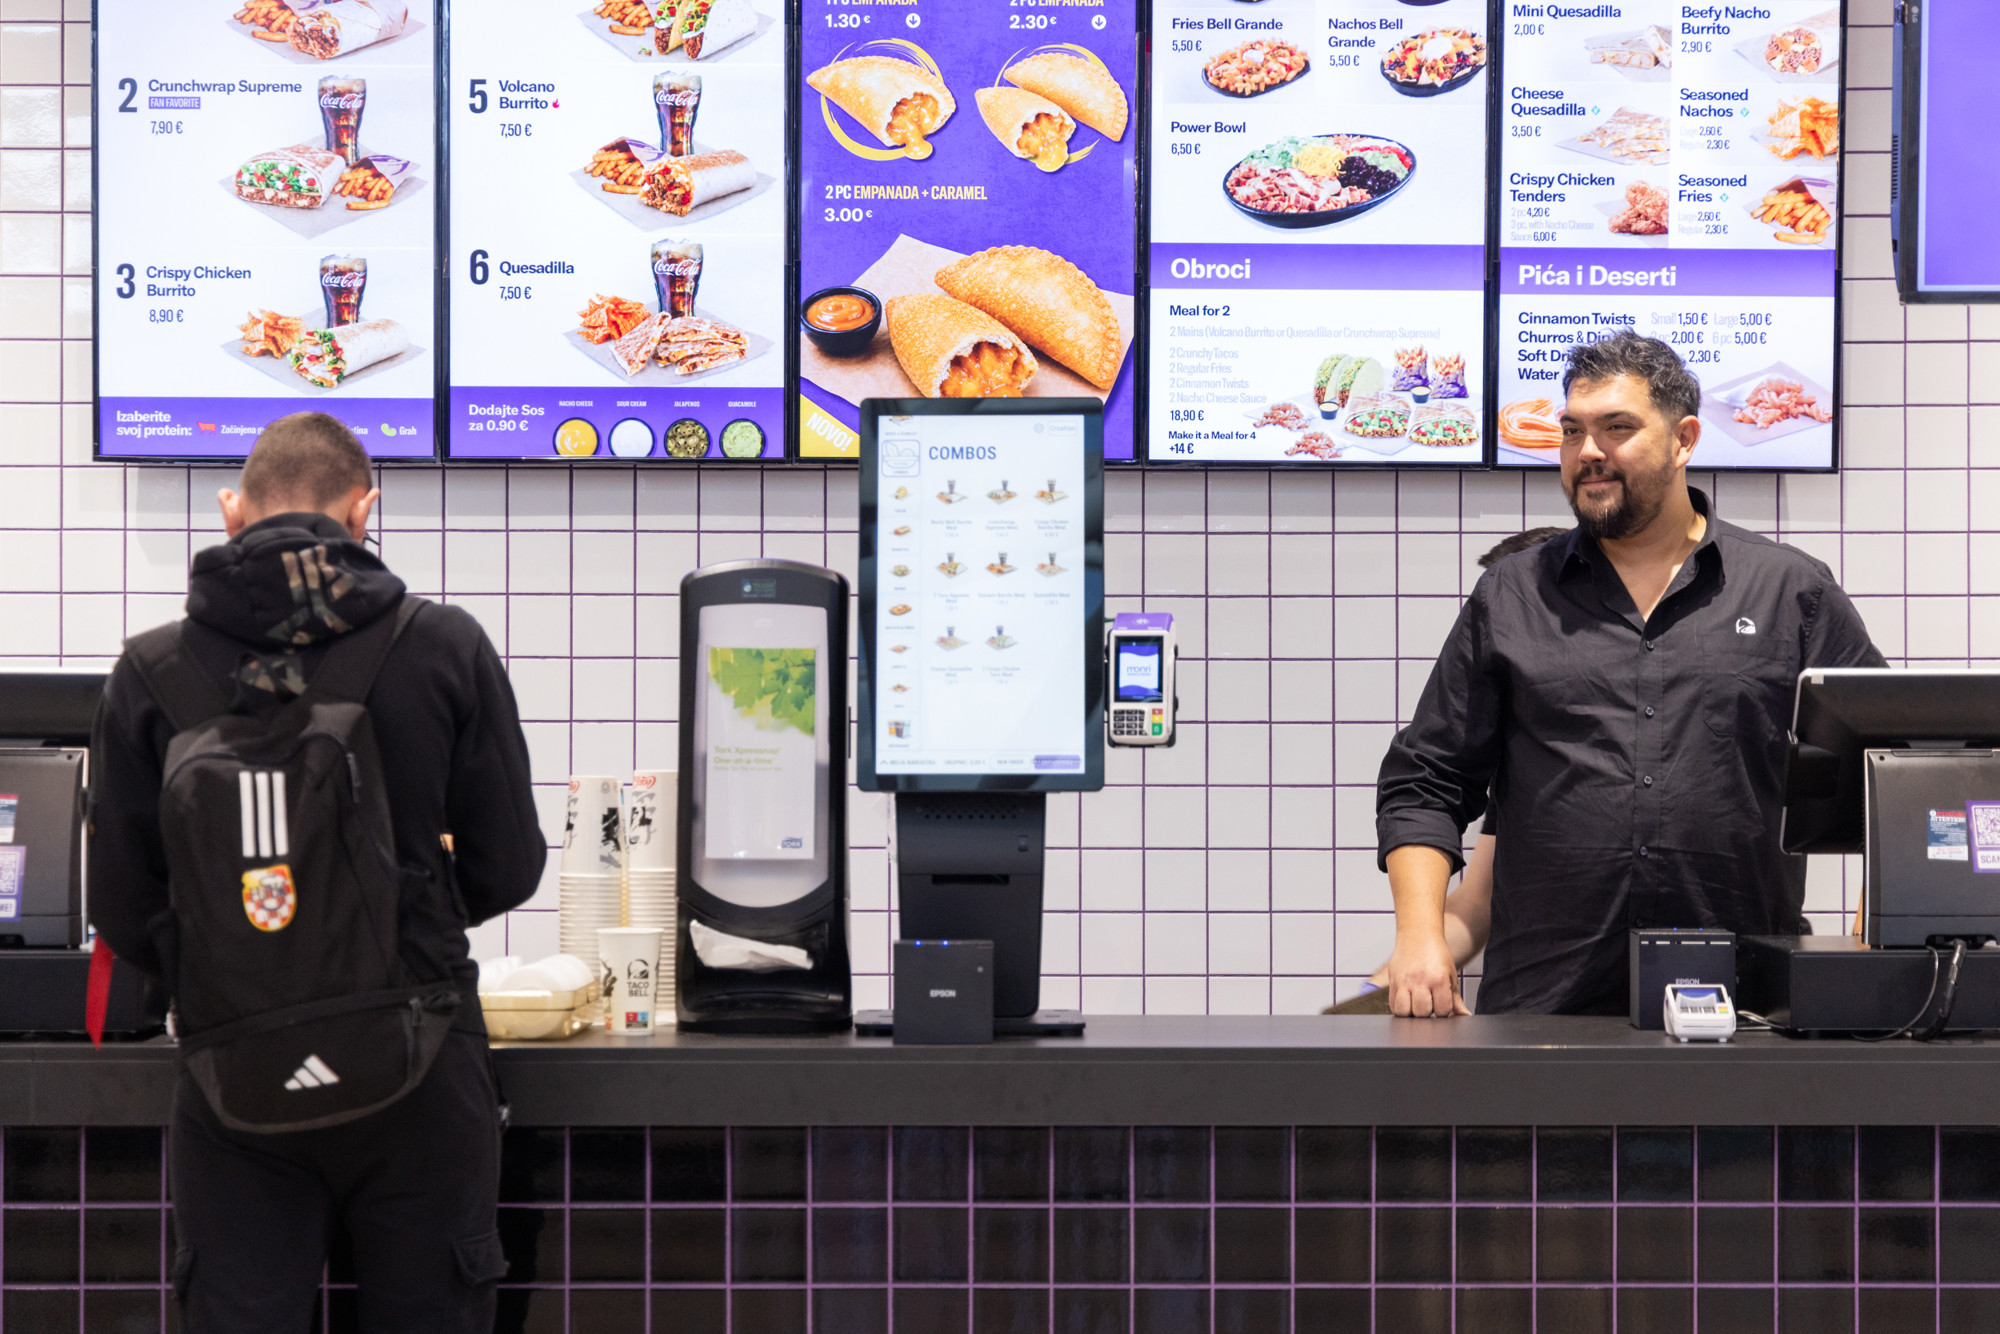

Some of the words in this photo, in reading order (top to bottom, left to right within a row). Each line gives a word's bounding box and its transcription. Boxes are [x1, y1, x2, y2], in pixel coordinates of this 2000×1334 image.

[1513, 5, 1543, 17] Mini
[1547, 5, 1621, 19] Quesadilla
[1682, 6, 1721, 20] Beefy
[1725, 6, 1770, 19] Nacho
[825, 14, 860, 28] 1.30
[1010, 16, 1047, 29] 2.30
[1172, 18, 1204, 30] Fries
[1207, 18, 1231, 30] Bell
[1234, 18, 1283, 30] Grande
[1329, 19, 1376, 30] Nachos
[1379, 19, 1403, 30] Bell
[1514, 24, 1535, 36] 2,00
[1538, 24, 1544, 35] €
[1682, 23, 1730, 35] Burrito
[1172, 40, 1194, 53] 5,50
[1195, 40, 1202, 51] €
[1329, 37, 1375, 48] Grande
[1682, 42, 1702, 54] 2,90
[1705, 42, 1712, 53] €
[1330, 56, 1351, 68] 5,50
[1353, 56, 1360, 66] €
[148, 79, 236, 94] Crunchwrap
[238, 79, 302, 94] Supreme
[499, 80, 554, 92] Volcano
[118, 78, 137, 112] 2
[469, 79, 488, 113] 5
[1512, 87, 1564, 99] Cheese
[1680, 89, 1748, 101] Seasoned
[150, 98, 165, 108] FAN
[166, 98, 199, 108] FAVORITE
[500, 97, 548, 109] Burrito
[1512, 103, 1586, 117] Quesadilla
[1680, 105, 1733, 117] Nachos
[151, 122, 173, 136] 7,90
[175, 122, 182, 134] €
[500, 124, 522, 138] 7,50
[525, 124, 532, 137] €
[1171, 122, 1211, 133] Power
[1214, 122, 1246, 133] Bowl
[1512, 126, 1532, 138] 3,50
[1535, 126, 1541, 137] €
[1171, 144, 1192, 156] 6,50
[1195, 144, 1201, 154] €
[1510, 173, 1554, 188] Crispy
[1558, 173, 1615, 186] Chicken
[1679, 174, 1746, 186] Seasoned
[826, 186, 834, 199] 2
[836, 186, 851, 199] PC
[854, 186, 919, 199] EMPANADA
[922, 189, 929, 197] +
[932, 186, 987, 199] CARAMEL
[1510, 190, 1565, 202] Tenders
[1679, 190, 1712, 202] Fries
[825, 208, 863, 221] 3.00
[866, 210, 872, 218] €
[470, 249, 489, 284] 6
[500, 262, 574, 275] Quesadilla
[1171, 258, 1251, 279] Obroci
[147, 266, 191, 282] Crispy
[194, 266, 251, 279] Chicken
[1519, 264, 1570, 285] Pića
[1577, 266, 1582, 285] i
[1590, 266, 1676, 286] Deserti
[116, 264, 135, 298] 3
[147, 285, 195, 296] Burrito
[500, 286, 521, 300] 7,50
[524, 286, 531, 299] €
[149, 309, 174, 324] 8,90
[176, 309, 183, 322] €
[1170, 306, 1199, 316] Meal
[1203, 306, 1220, 316] for
[1222, 306, 1230, 316] 2
[1519, 312, 1590, 325] Cinnamon
[1592, 312, 1635, 325] Twists
[1651, 313, 1676, 324] Small
[1678, 313, 1698, 326] 1,50
[1701, 313, 1708, 324] €
[1714, 314, 1739, 327] Large
[1740, 314, 1762, 326] 5,00
[1765, 314, 1772, 325] €
[1170, 326, 1176, 336] 2
[1178, 326, 1203, 337] Mains
[1206, 326, 1243, 338] (Volcano
[1245, 326, 1274, 338] Burrito
[1276, 329, 1284, 338] or
[1286, 327, 1332, 339] Quesadilla
[1334, 330, 1342, 338] or
[1344, 327, 1397, 340] Crunchwrap
[1399, 327, 1440, 340] Supreme)
[1519, 331, 1574, 343] Churros
[1577, 332, 1584, 343] &
[1672, 332, 1694, 345] 2,00
[1697, 332, 1704, 343] €
[1713, 332, 1718, 343] 6
[1721, 335, 1732, 346] pc
[1735, 332, 1757, 345] 5,00
[1760, 332, 1766, 344] €
[1518, 350, 1547, 361] Soft
[1689, 351, 1711, 364] 2,30
[1714, 351, 1720, 362] €
[1518, 368, 1559, 380] Water
[1170, 393, 1175, 402] 2
[1177, 393, 1204, 403] Nacho
[1206, 393, 1238, 403] Cheese
[1240, 393, 1267, 403] Sauce
[116, 411, 171, 422] Izaberite
[469, 405, 518, 418] Dodajte
[522, 405, 544, 416] Sos
[1171, 410, 1195, 422] 18,90
[1198, 410, 1204, 421] €
[116, 426, 140, 438] svoj
[143, 425, 192, 438] protein:
[221, 425, 255, 436] Začinjena
[399, 426, 416, 436] Grah
[469, 422, 483, 431] za
[486, 420, 516, 431] 0.90
[519, 420, 528, 431] €
[806, 412, 854, 452] NOVO!
[1169, 431, 1192, 440] Make
[1195, 431, 1201, 440] it
[1211, 431, 1232, 440] Meal
[1234, 431, 1246, 440] for
[1249, 432, 1256, 440] 4
[929, 446, 996, 460] COMBOS
[1169, 443, 1185, 454] +14
[1187, 443, 1194, 454] €
